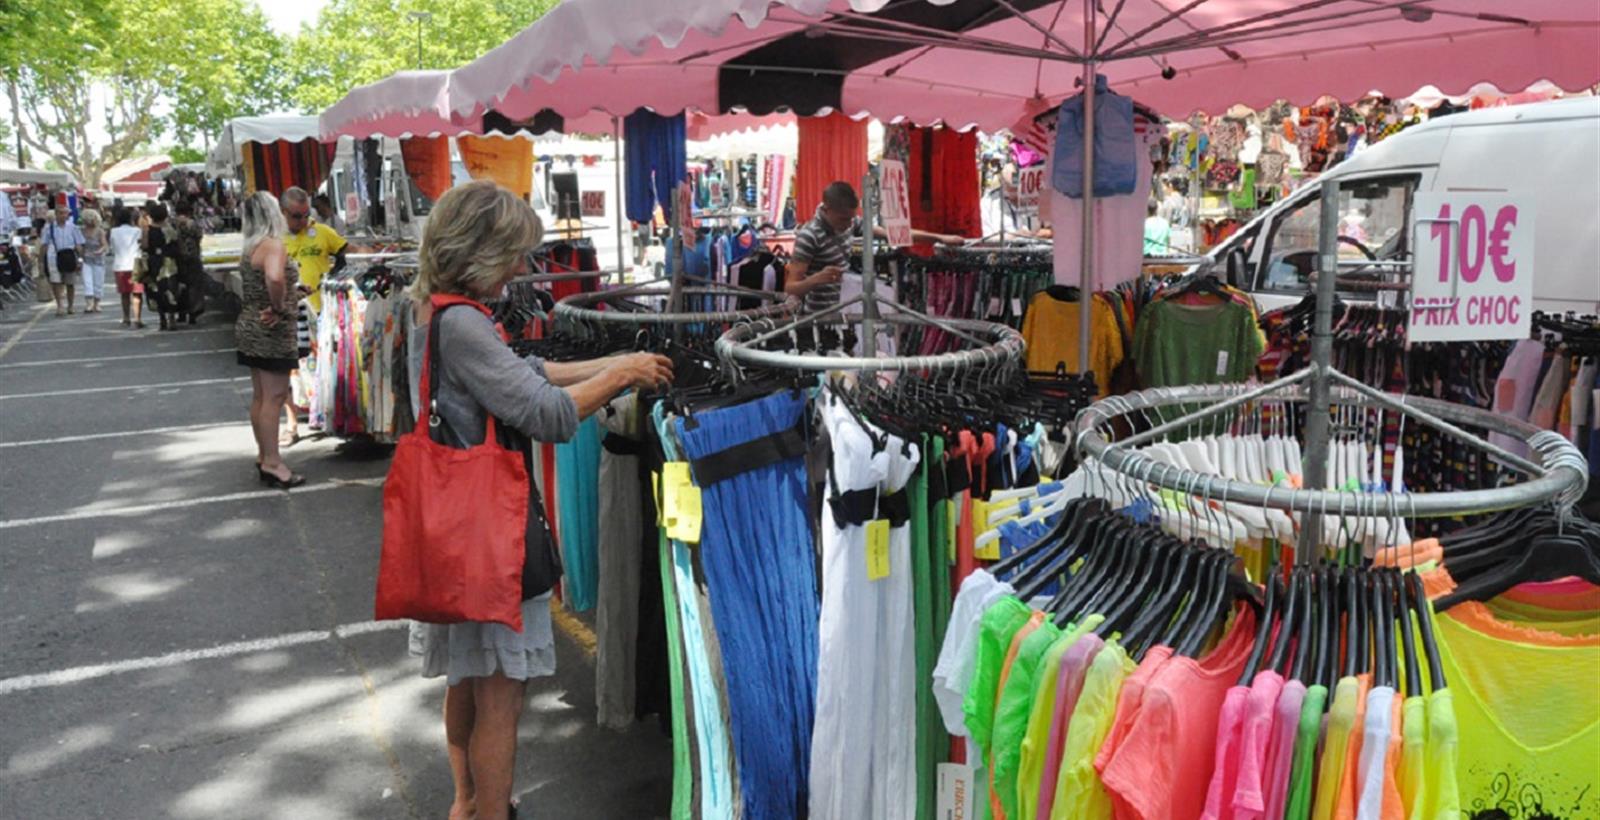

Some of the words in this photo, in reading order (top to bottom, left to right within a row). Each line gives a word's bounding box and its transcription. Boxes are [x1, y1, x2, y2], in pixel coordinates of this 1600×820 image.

[1020, 170, 1044, 194] 10€
[1430, 204, 1519, 284] 10€
[1412, 297, 1461, 326] PRIX
[1466, 295, 1521, 325] CHOC
